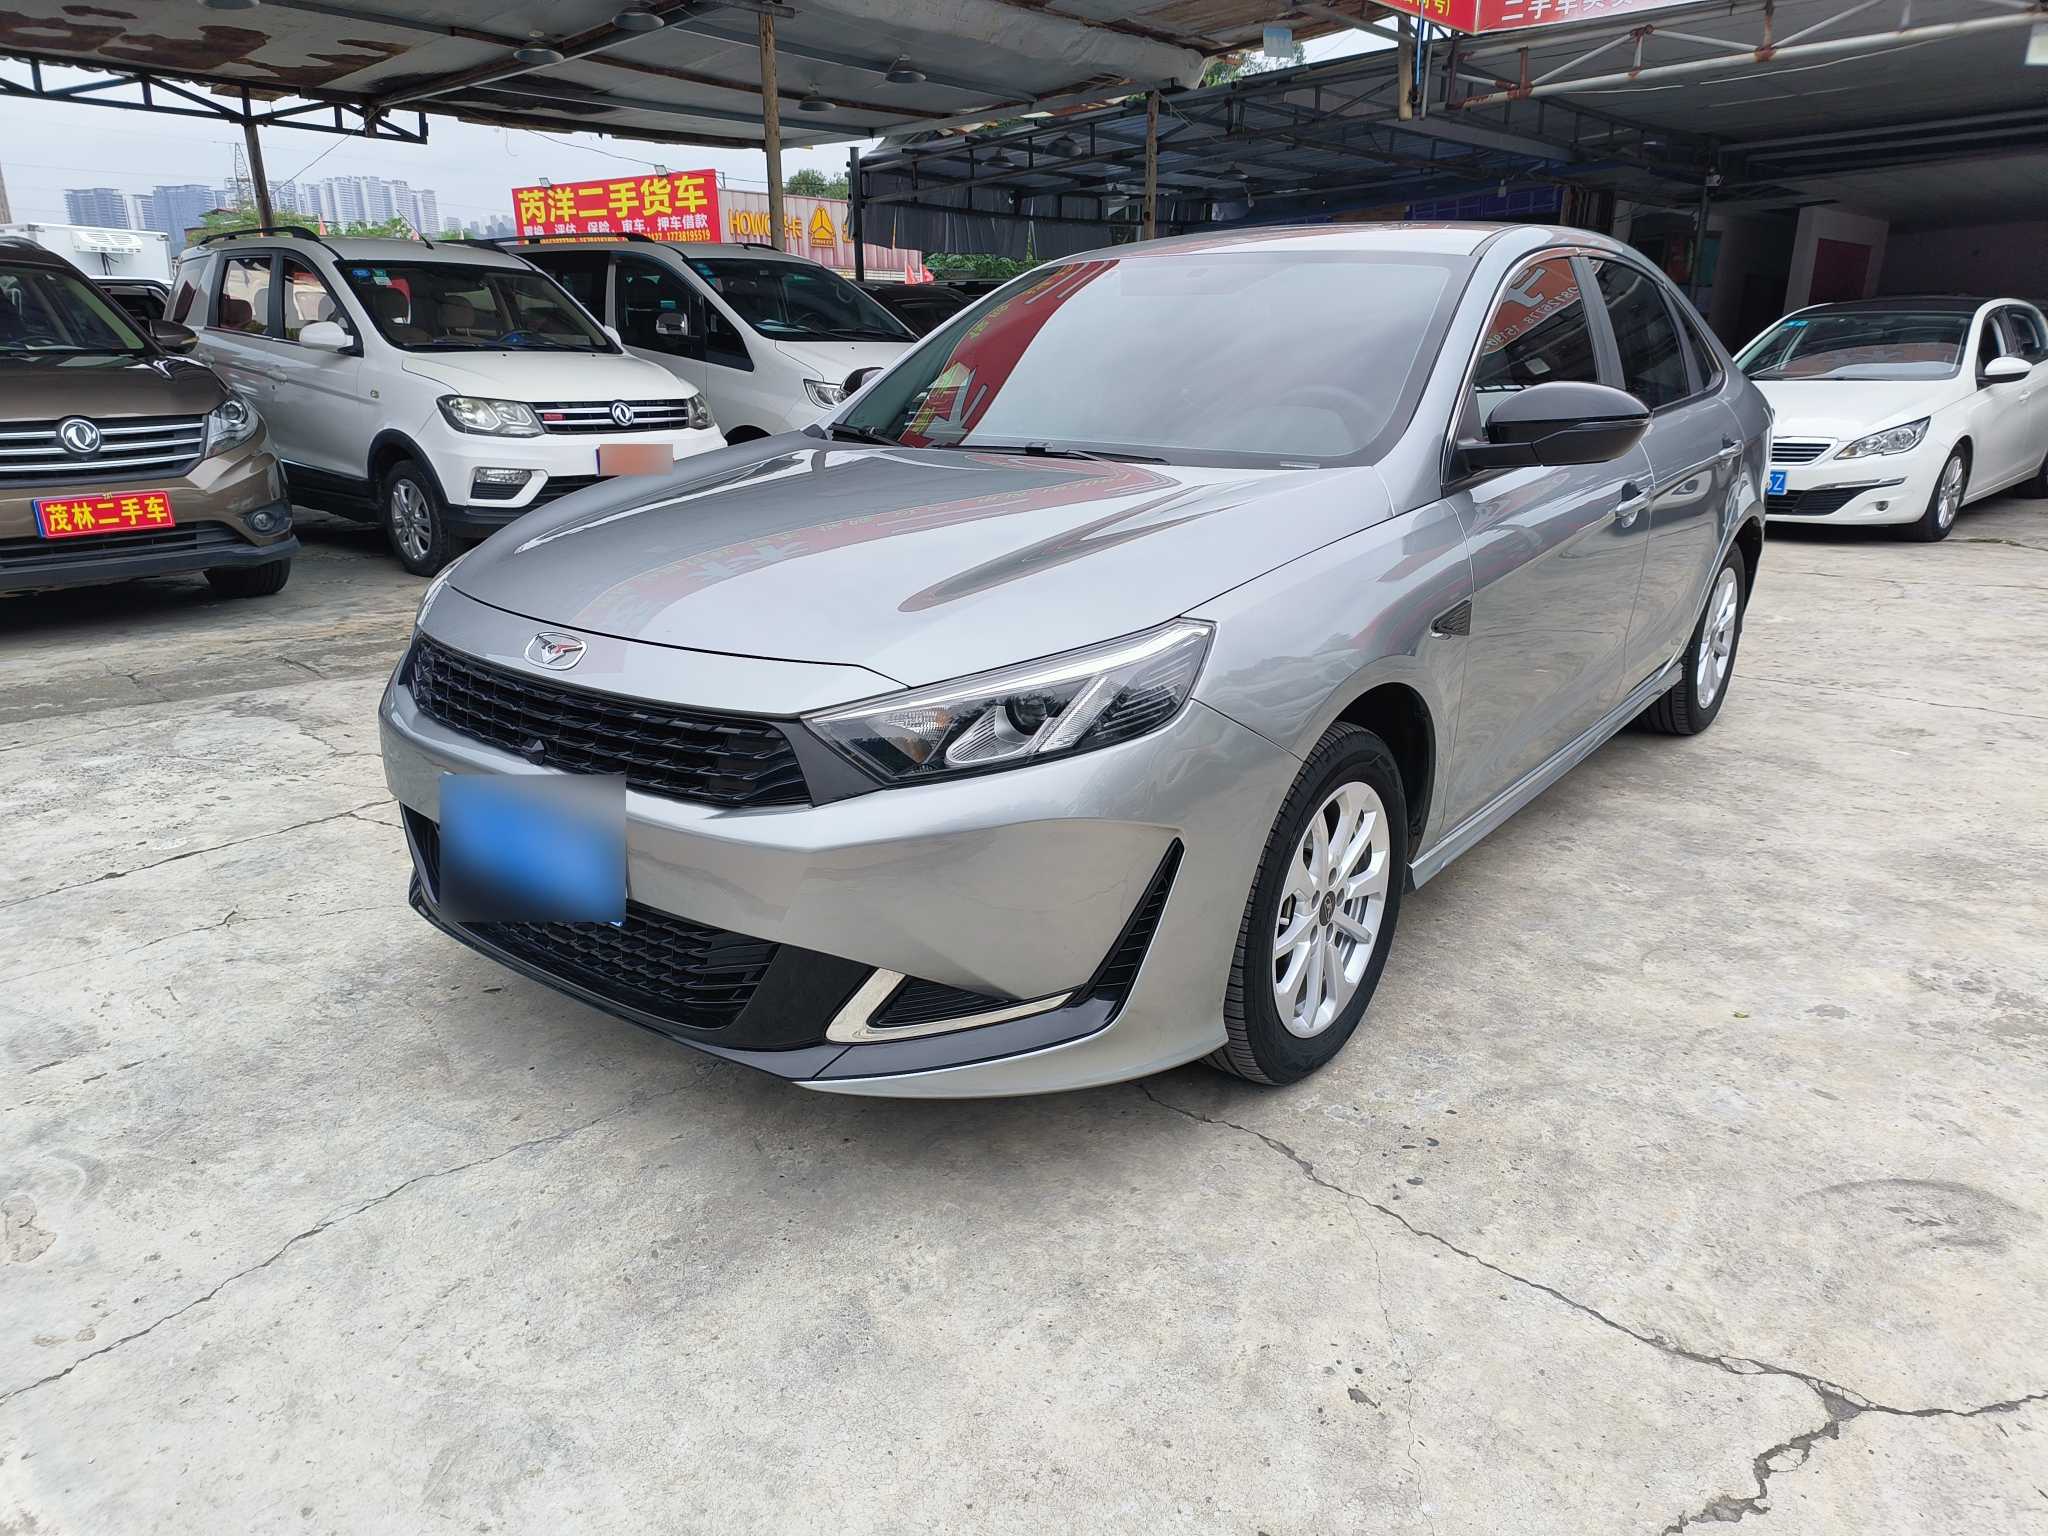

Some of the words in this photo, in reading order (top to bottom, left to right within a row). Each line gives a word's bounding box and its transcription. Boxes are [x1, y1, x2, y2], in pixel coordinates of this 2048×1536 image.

[517, 175, 708, 224] 芮洋二手货车
[46, 497, 168, 531] 茂林二手车
